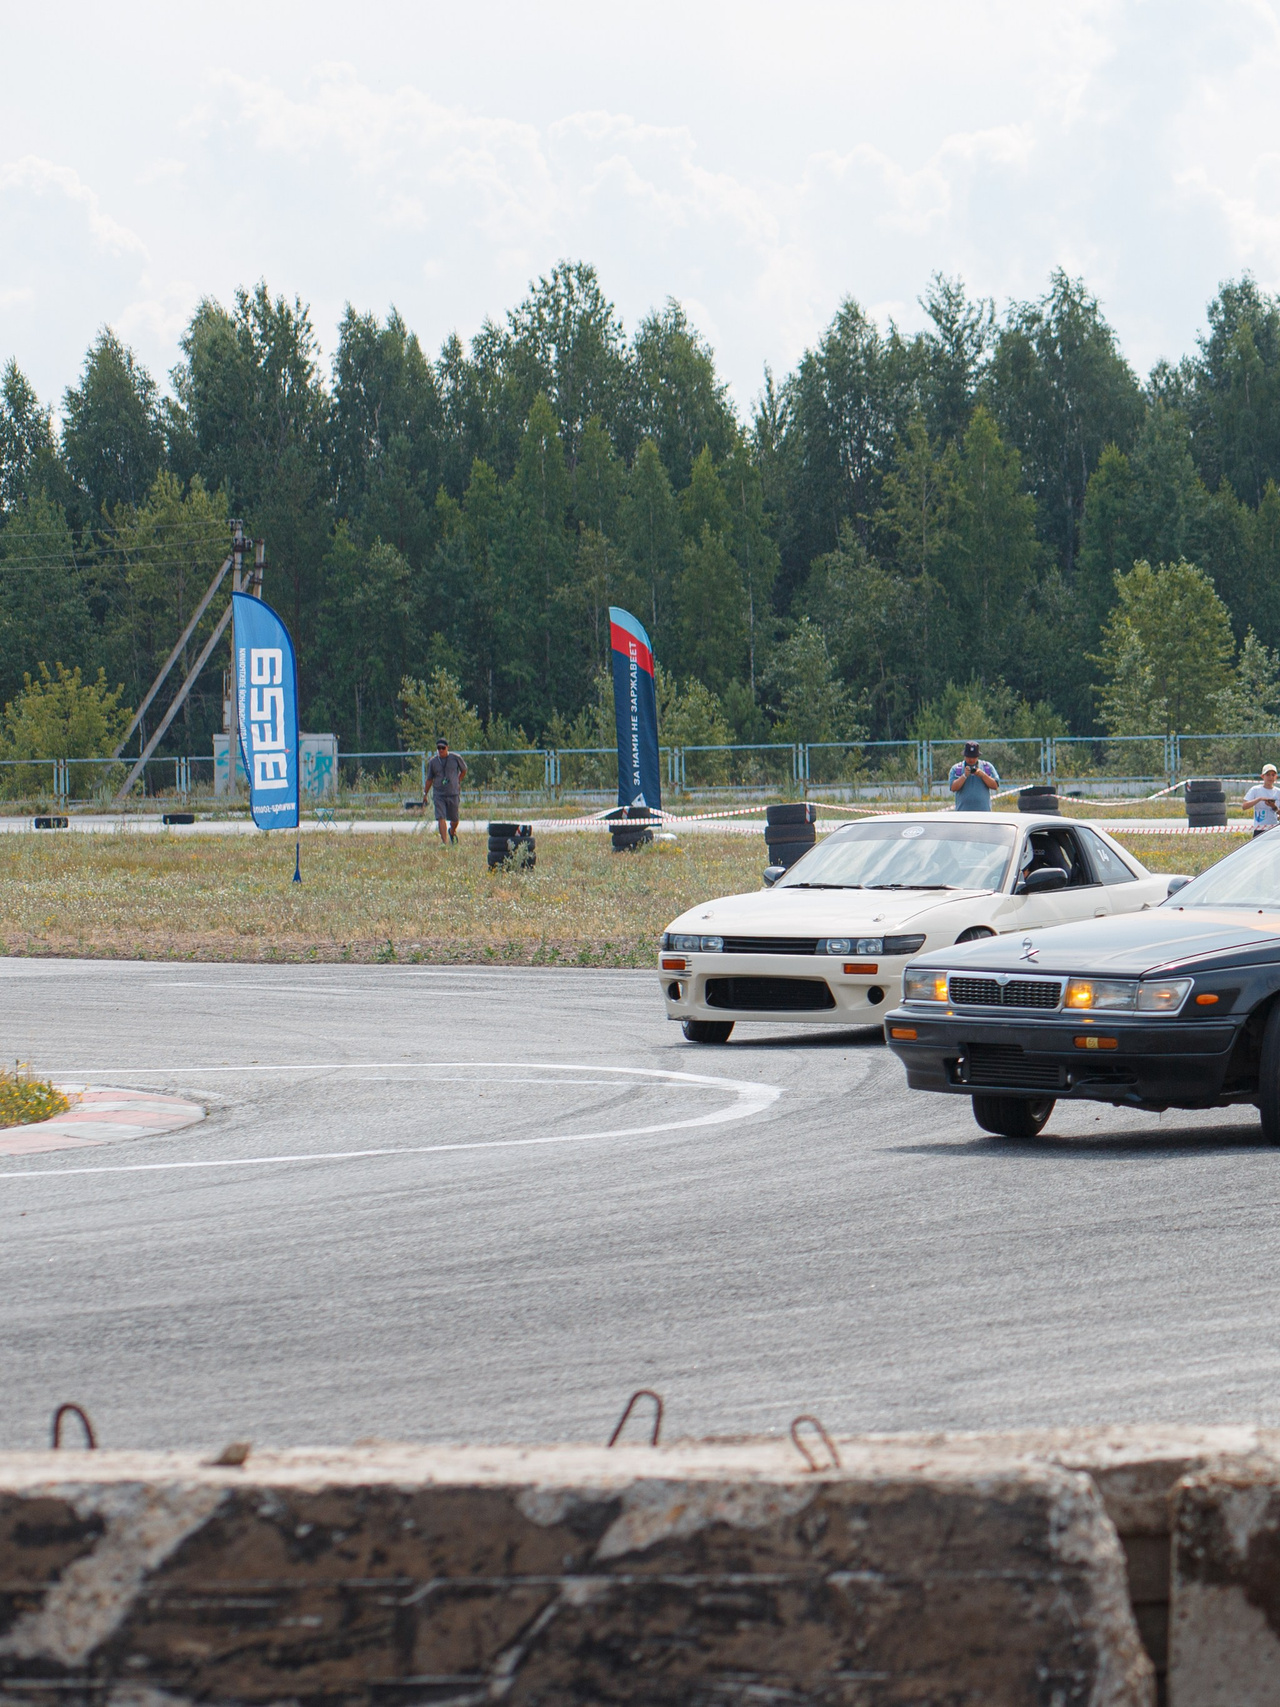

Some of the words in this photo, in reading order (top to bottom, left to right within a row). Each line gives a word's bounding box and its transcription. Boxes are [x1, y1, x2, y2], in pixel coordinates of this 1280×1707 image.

[628, 641, 638, 712] ЗАРЖАВЕЕТ
[630, 715, 638, 731] НЕ
[631, 734, 640, 768] НАМИ
[632, 770, 641, 786] ЗА
[1097, 849, 1110, 862] 14
